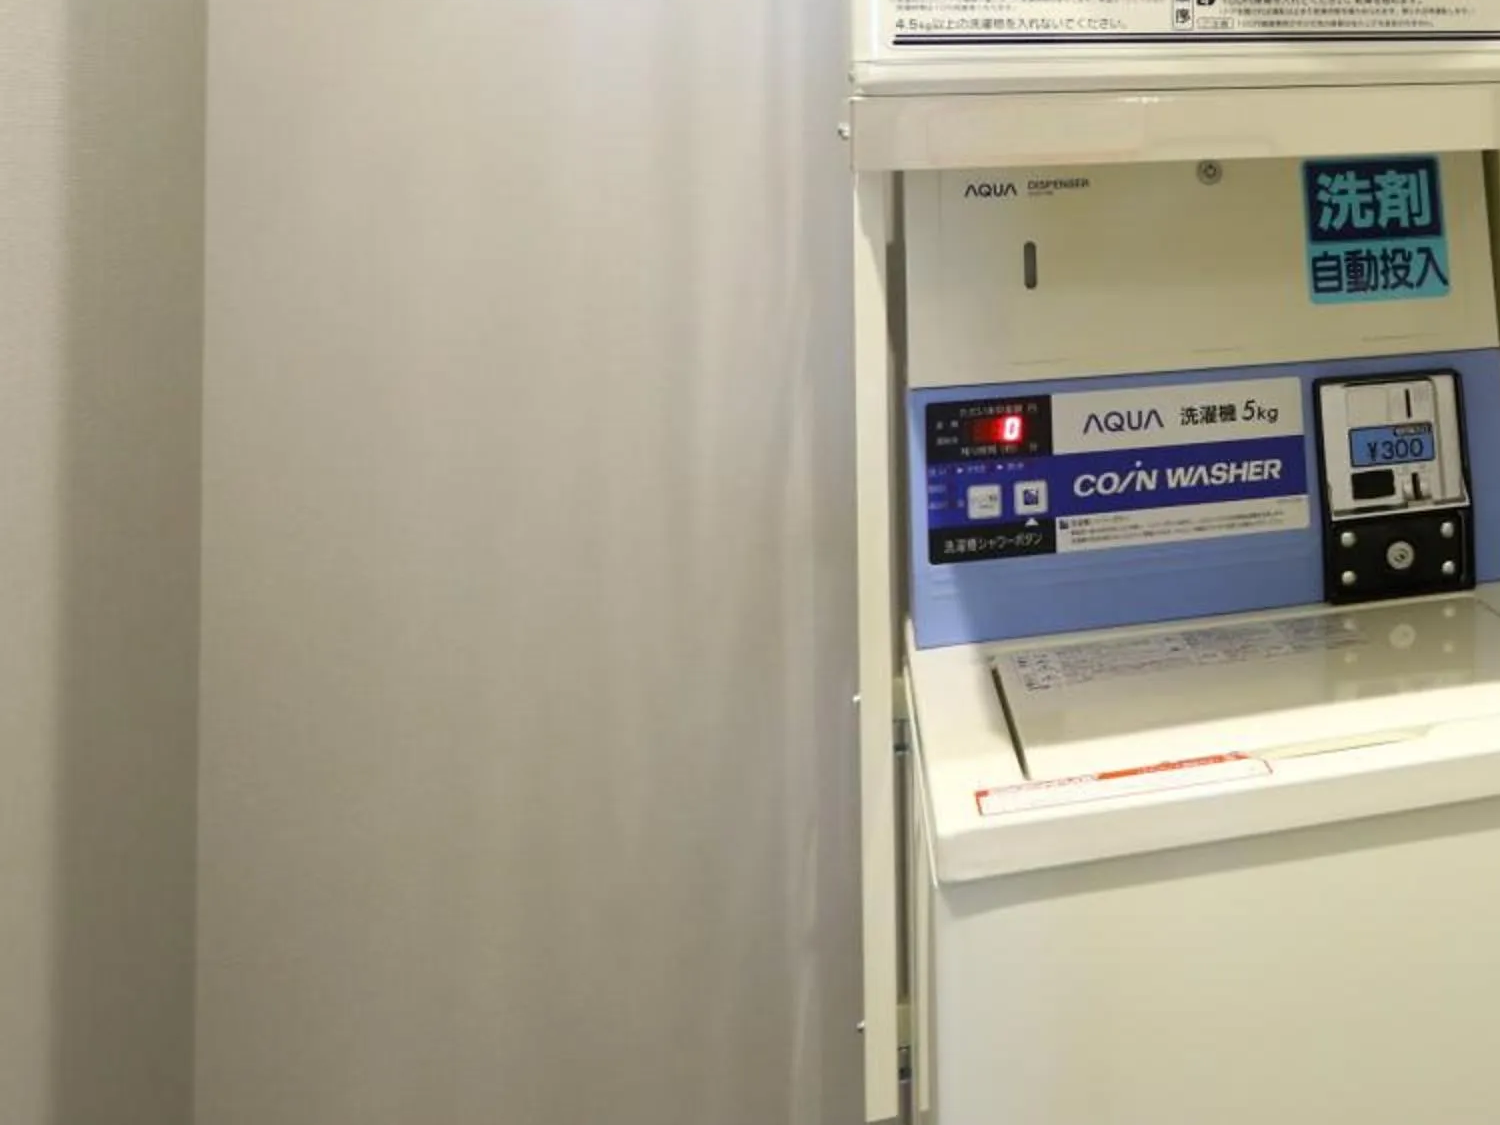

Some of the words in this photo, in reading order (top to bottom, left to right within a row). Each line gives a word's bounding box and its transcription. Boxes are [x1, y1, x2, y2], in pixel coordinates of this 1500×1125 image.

[964, 183, 1017, 198] AQUA
[1027, 178, 1090, 190] DISPENSER
[1316, 167, 1432, 231] 洗剤
[1311, 248, 1450, 295] 自動投入
[1003, 417, 1021, 440] 0
[1083, 408, 1164, 435] AQUA
[1180, 403, 1237, 427] 洗濯機
[1242, 400, 1279, 425] 5kg
[1367, 438, 1424, 461] ¥300
[1073, 460, 1158, 498] COIN
[1167, 459, 1283, 490] WASHER
